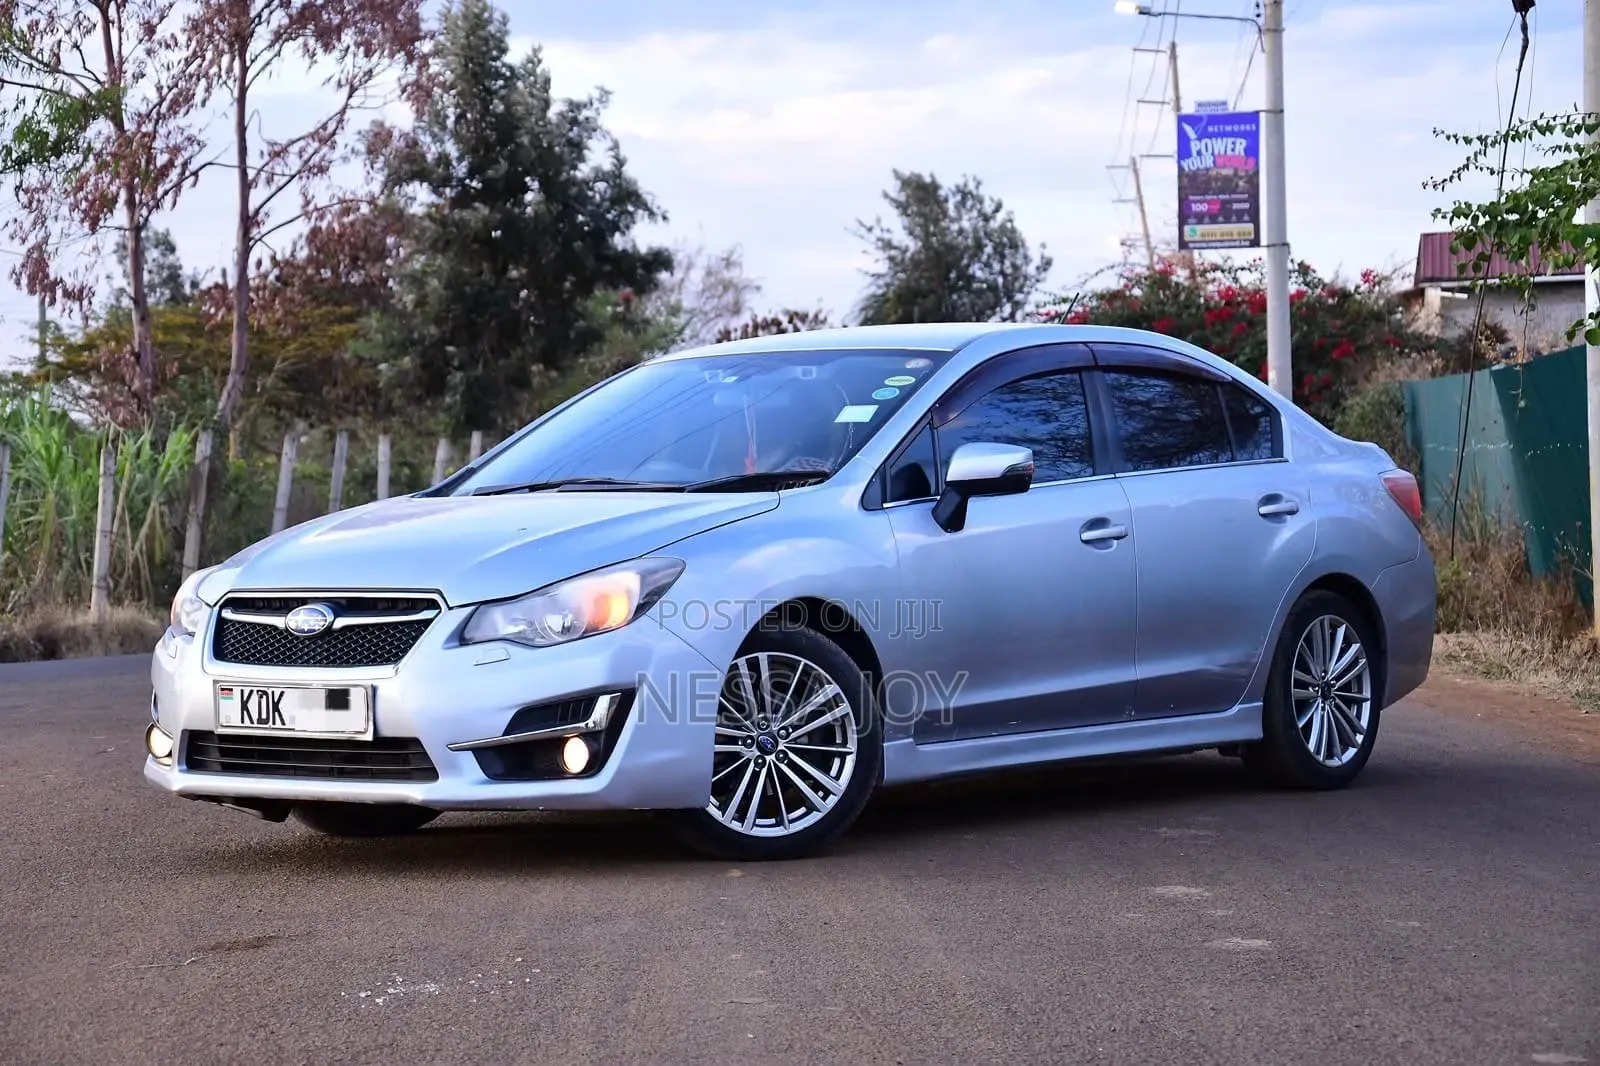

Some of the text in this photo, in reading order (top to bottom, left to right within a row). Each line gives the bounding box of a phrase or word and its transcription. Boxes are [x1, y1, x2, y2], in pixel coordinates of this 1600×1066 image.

[1190, 137, 1247, 157] POWER
[1180, 155, 1214, 172] YOUR
[1191, 203, 1208, 212] 100
[240, 688, 287, 726] KDK
